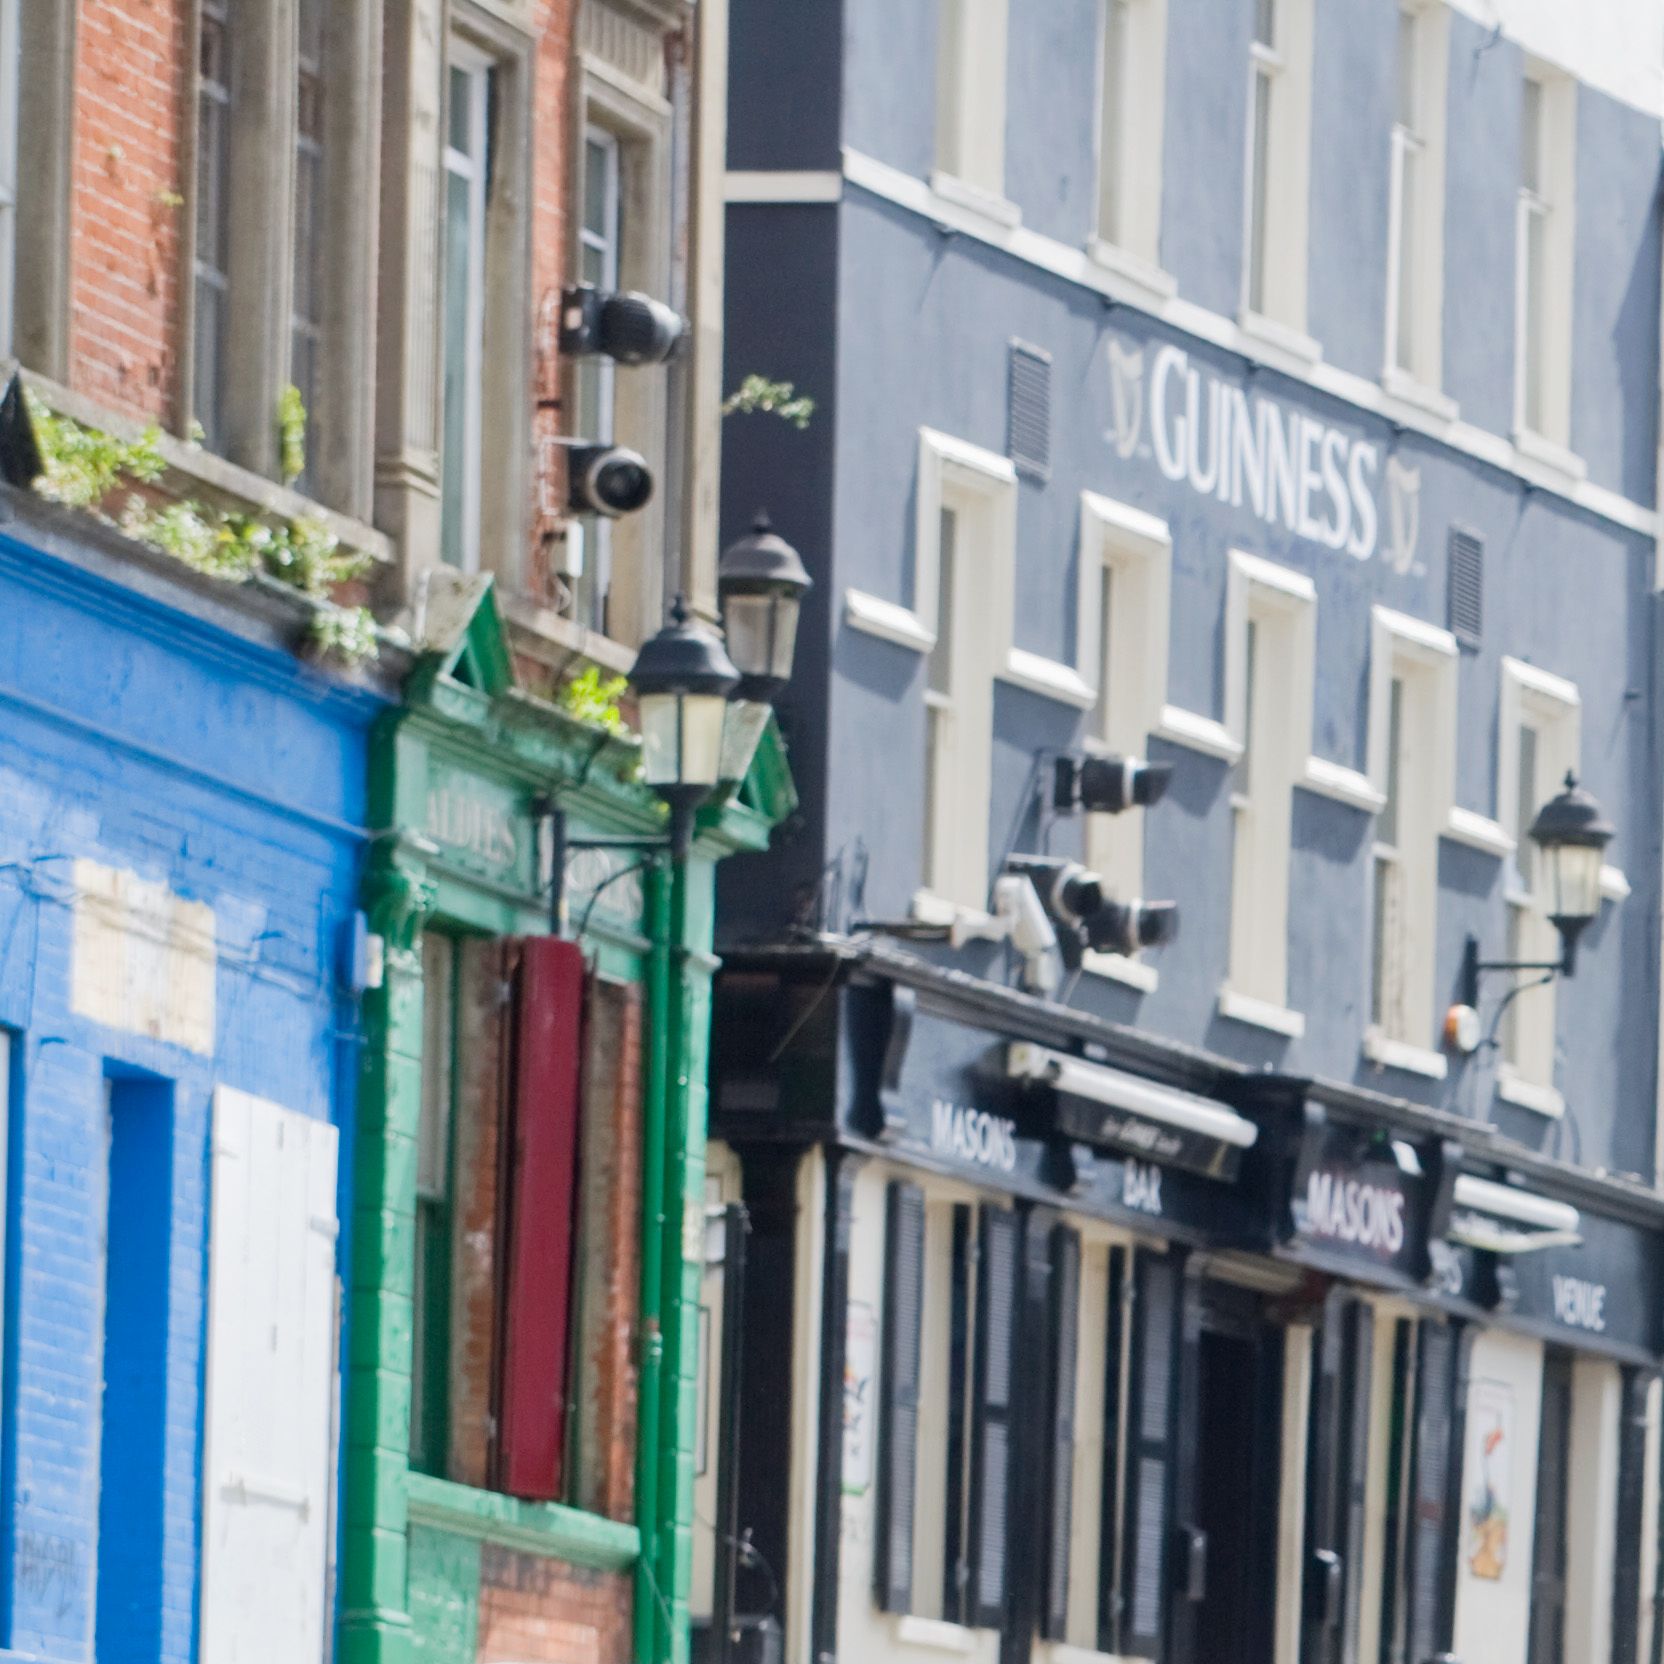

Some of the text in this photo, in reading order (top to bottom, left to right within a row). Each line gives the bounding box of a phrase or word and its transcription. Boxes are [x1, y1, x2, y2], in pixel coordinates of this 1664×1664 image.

[1150, 345, 1378, 561] GUINNESS
[931, 1098, 1163, 1215] MASONS BAR
[1306, 1169, 1406, 1255] MASONS
[1552, 1274, 1607, 1333] VENUE
